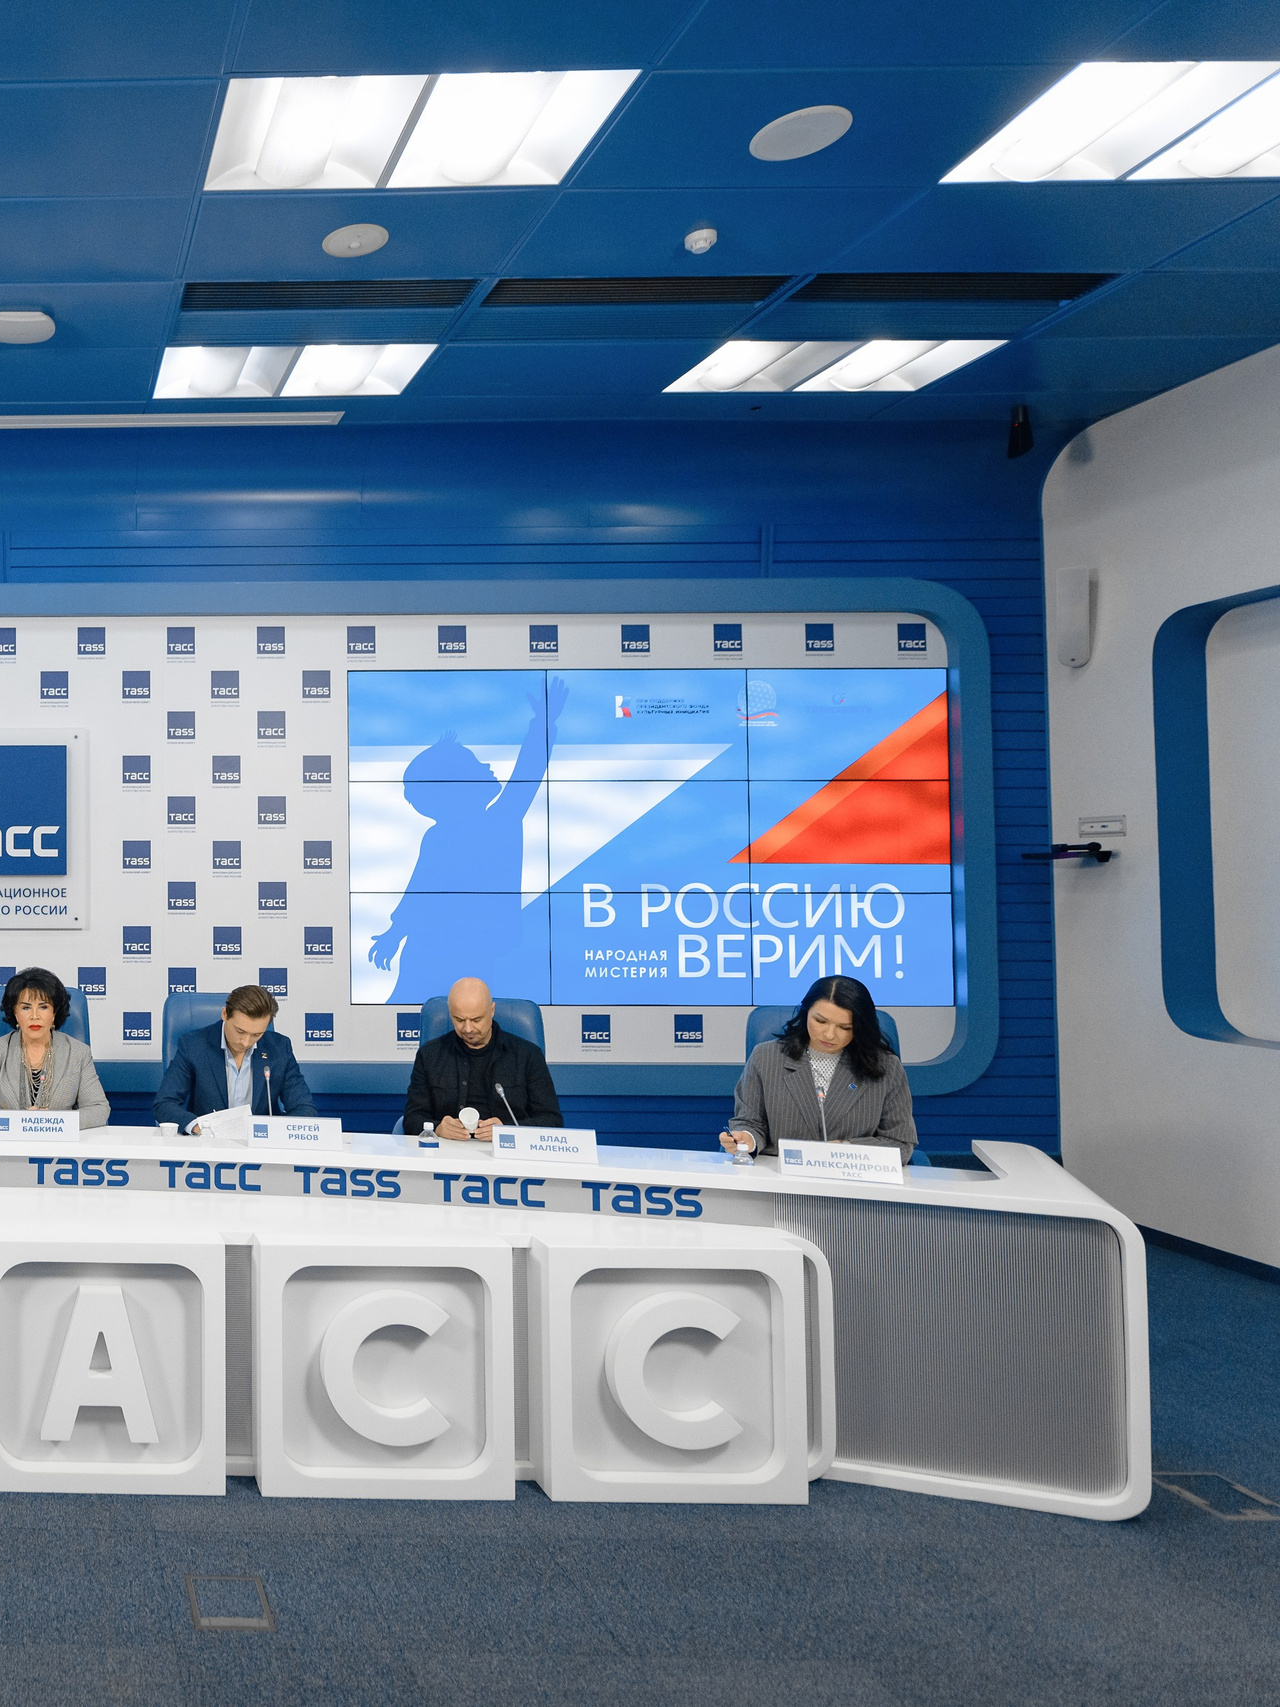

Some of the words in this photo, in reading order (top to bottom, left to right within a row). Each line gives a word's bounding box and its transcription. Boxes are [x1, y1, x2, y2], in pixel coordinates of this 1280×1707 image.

[14, 905, 68, 916] РОССИИ
[582, 883, 616, 928] В
[640, 882, 906, 929] РОССИЮ
[584, 949, 668, 962] НАРОДНАЯ
[678, 934, 904, 979] ВЕРИМ!
[584, 966, 668, 978] МИСТЕРИЯ
[286, 1124, 320, 1132] СЕРГЕЙ
[540, 1135, 568, 1144] ВЛАД
[530, 1144, 580, 1154] МАЛЕНКО
[830, 1152, 870, 1162] ИРИНА
[28, 1158, 130, 1188] TASS
[805, 1160, 898, 1174] АЛЕКСАНДРОВА
[160, 1160, 263, 1192] ТАСС
[294, 1166, 402, 1198] TASS
[432, 1173, 547, 1208] ТАСС
[581, 1182, 704, 1219] TASS
